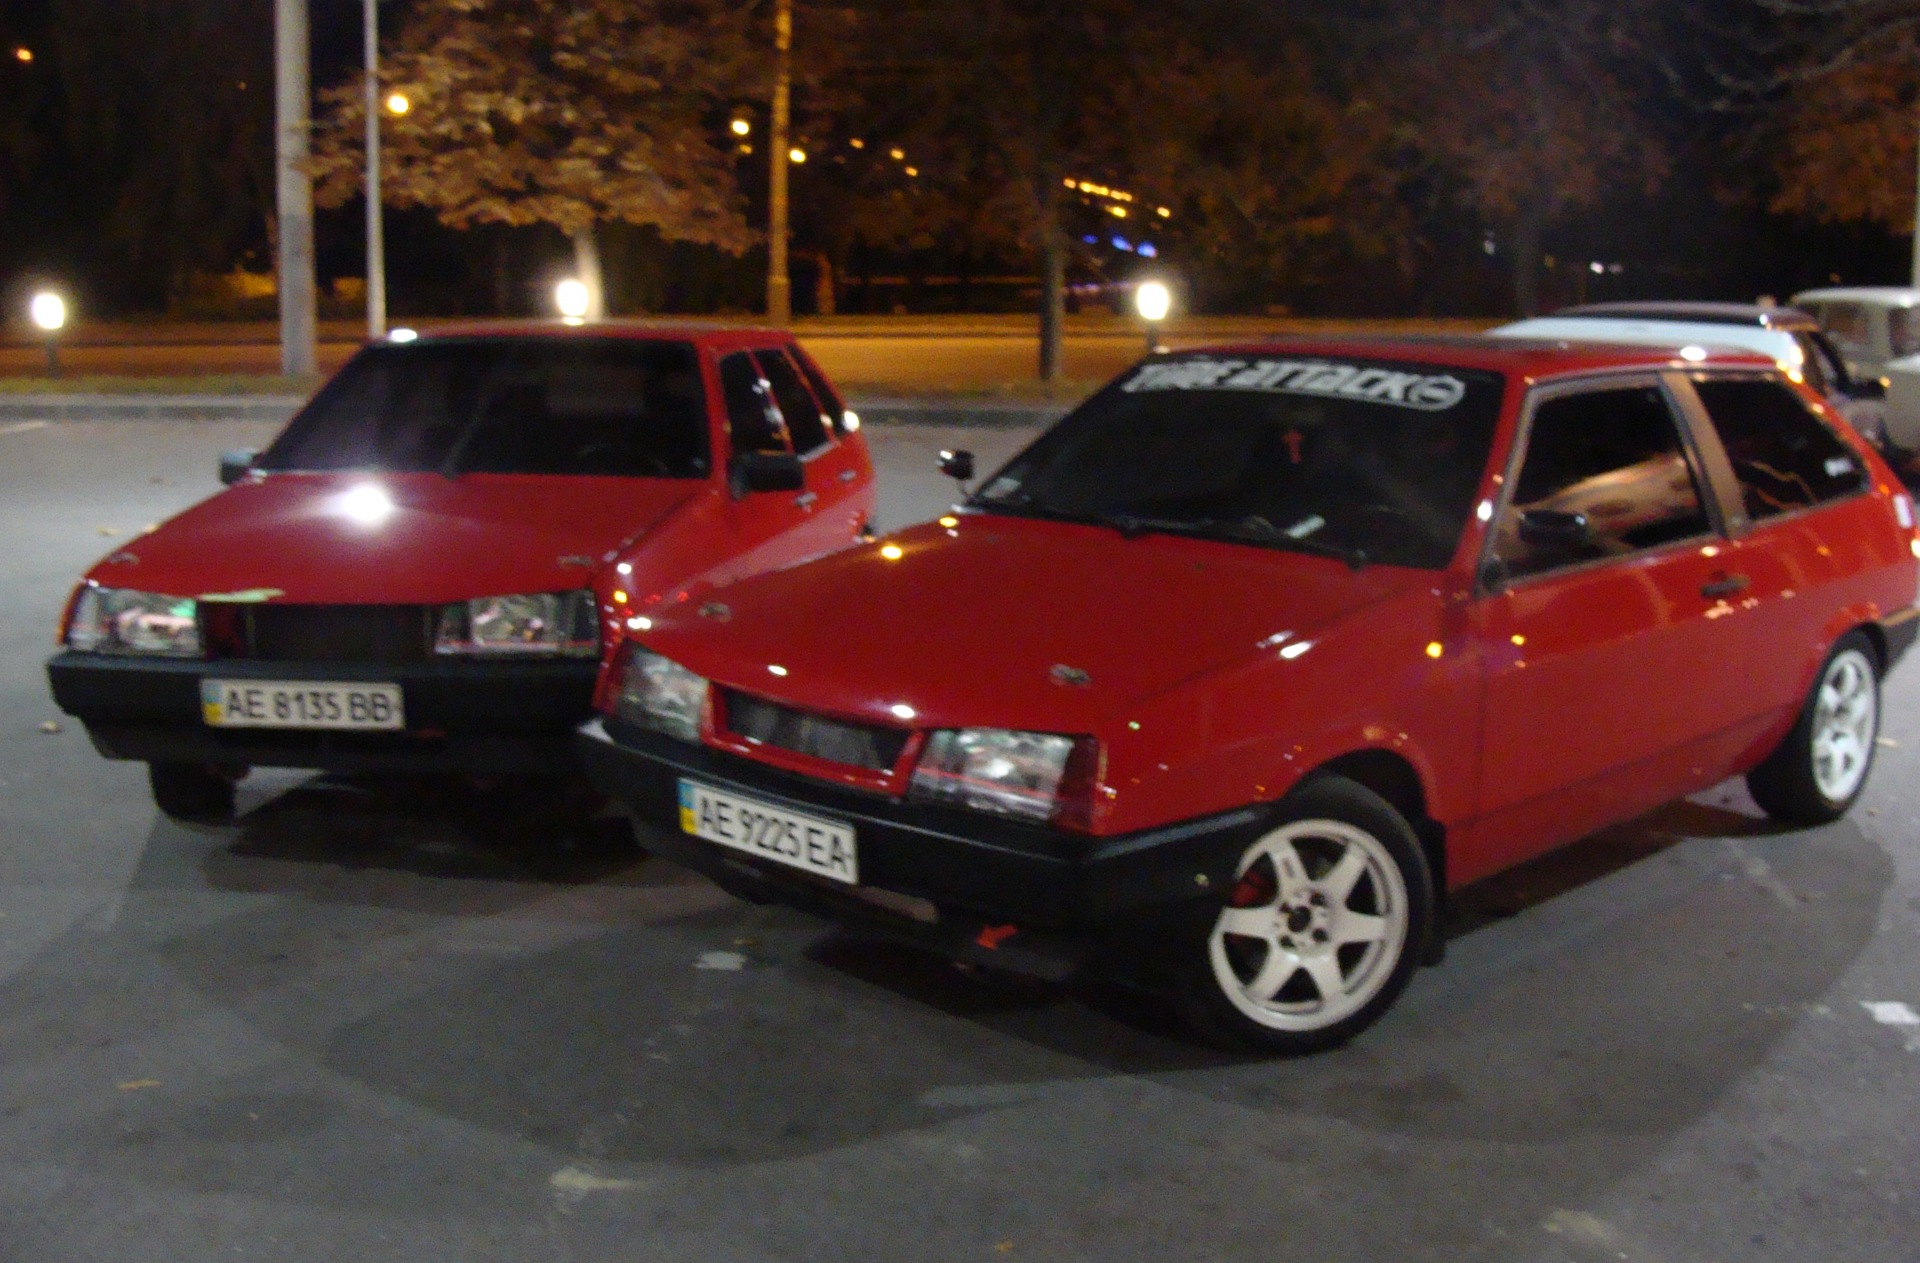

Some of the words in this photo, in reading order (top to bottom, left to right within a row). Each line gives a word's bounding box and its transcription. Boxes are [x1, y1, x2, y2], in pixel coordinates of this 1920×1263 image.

[227, 688, 265, 719] AE
[273, 690, 342, 721] 8135
[348, 691, 391, 722] BB
[701, 796, 735, 839] AE
[740, 807, 801, 858] 9225
[807, 826, 849, 874] EA
